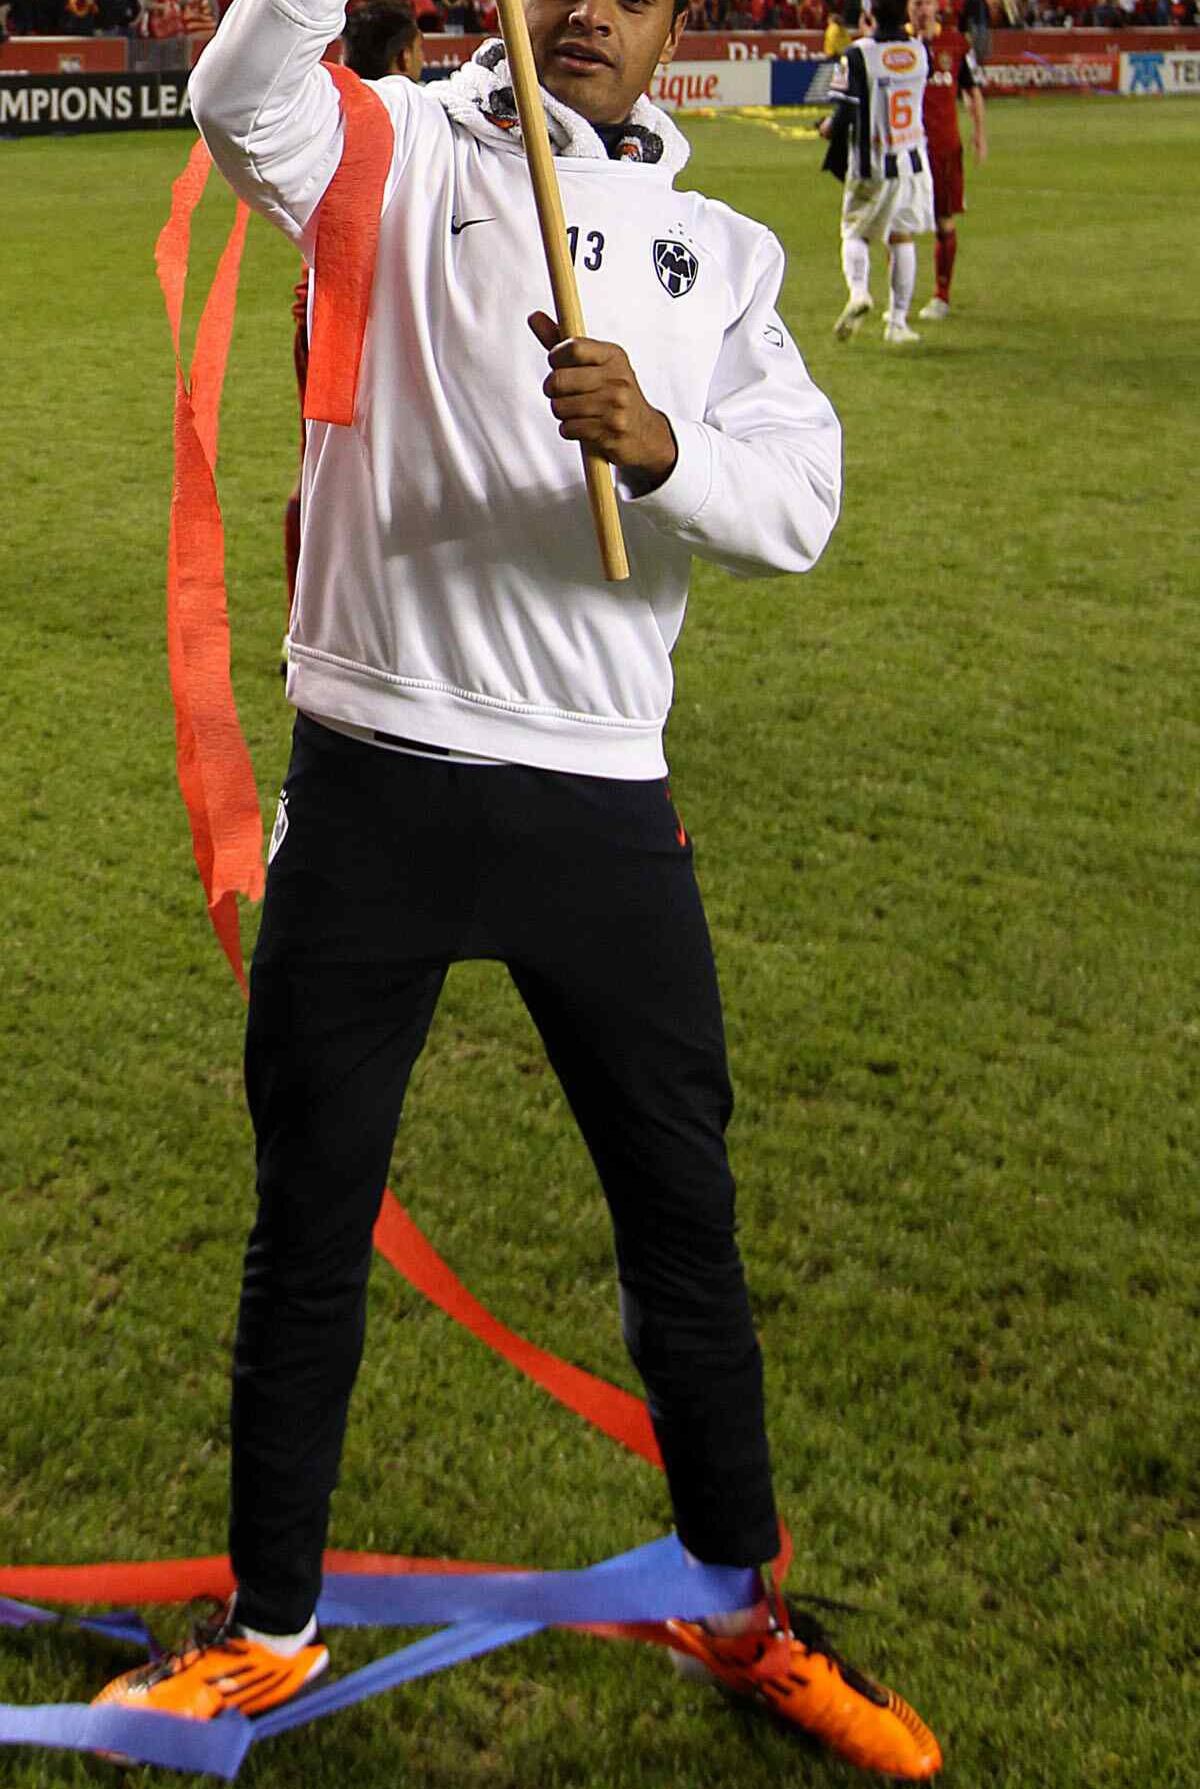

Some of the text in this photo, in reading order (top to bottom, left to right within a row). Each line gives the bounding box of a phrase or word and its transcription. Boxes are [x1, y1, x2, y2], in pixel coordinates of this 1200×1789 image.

[140, 83, 191, 117] LEA
[650, 70, 720, 107] ique
[890, 90, 912, 130] 6
